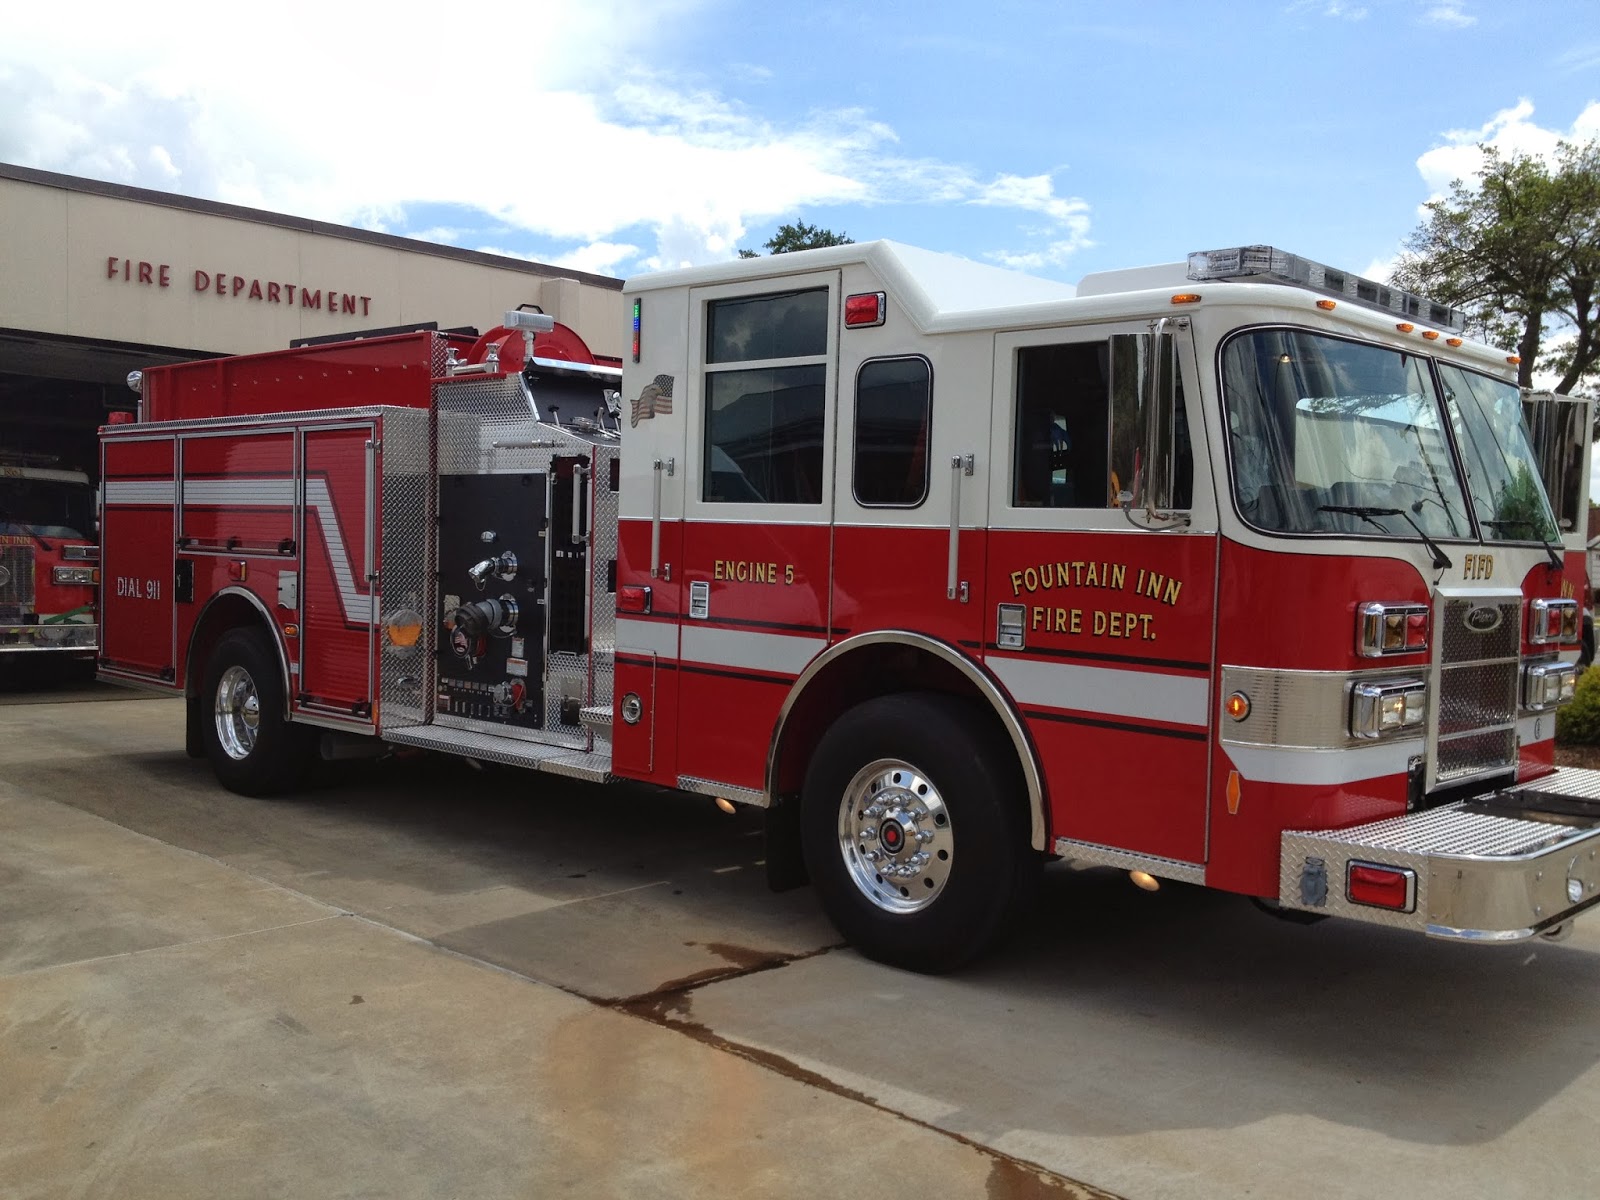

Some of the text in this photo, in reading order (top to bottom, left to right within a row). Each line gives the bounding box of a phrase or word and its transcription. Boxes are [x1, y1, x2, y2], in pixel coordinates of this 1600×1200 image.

[107, 256, 372, 316] FIRE DEPARTMENT
[13, 536, 31, 545] INN
[714, 559, 795, 586] ENGINE 5
[1463, 554, 1494, 580] FIFD
[117, 576, 161, 600] DIAL 911
[1010, 561, 1183, 606] FOUNTAIN INN
[1032, 606, 1157, 640] FIRE DEPT.
